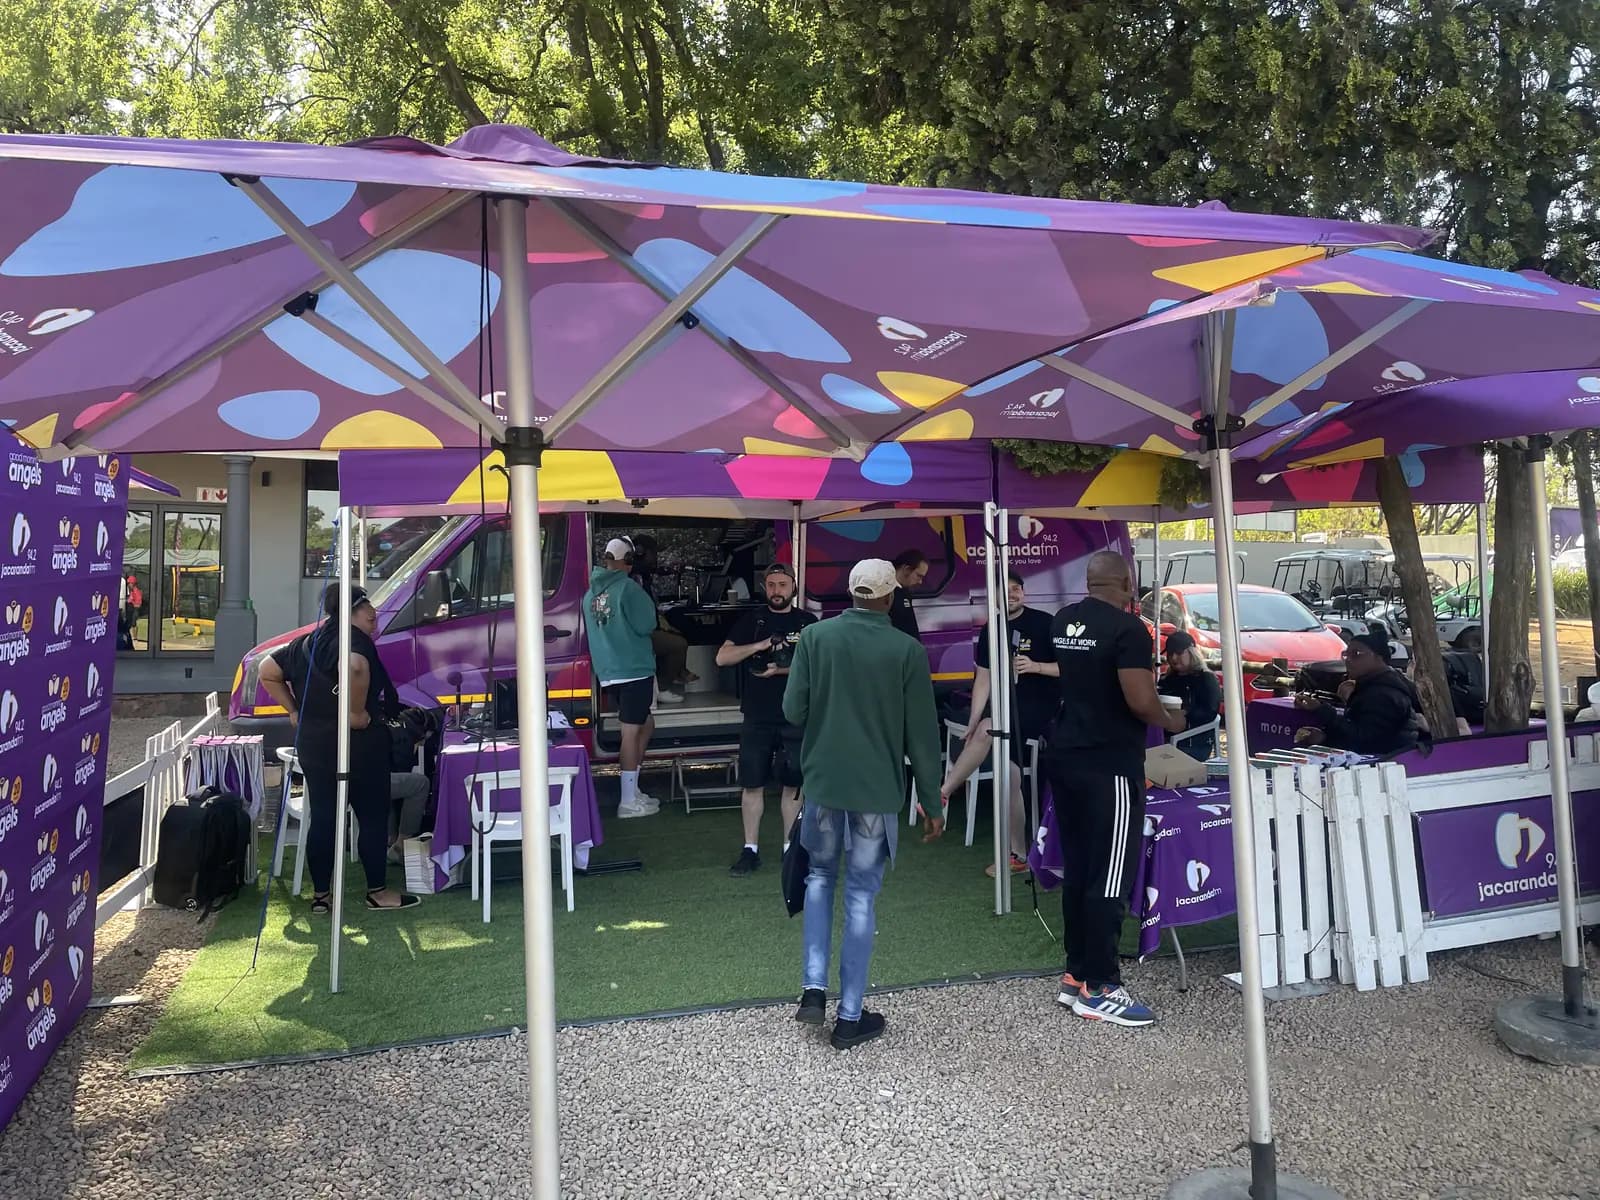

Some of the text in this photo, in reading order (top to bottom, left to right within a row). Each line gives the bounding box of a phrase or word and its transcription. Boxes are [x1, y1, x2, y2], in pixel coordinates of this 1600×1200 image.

[9, 462, 42, 490] angels
[94, 480, 116, 503] angels
[1042, 533, 1058, 542] 94.2
[52, 548, 78, 575] angels
[84, 617, 107, 644] angels
[1078, 639, 1097, 647] WORK
[40, 702, 67, 733] angels
[1261, 722, 1291, 736] more
[74, 756, 96, 786] angels
[0, 805, 19, 843] gels
[30, 855, 57, 893] angels
[1478, 871, 1557, 902] jacaranda
[27, 1006, 57, 1051] angels
